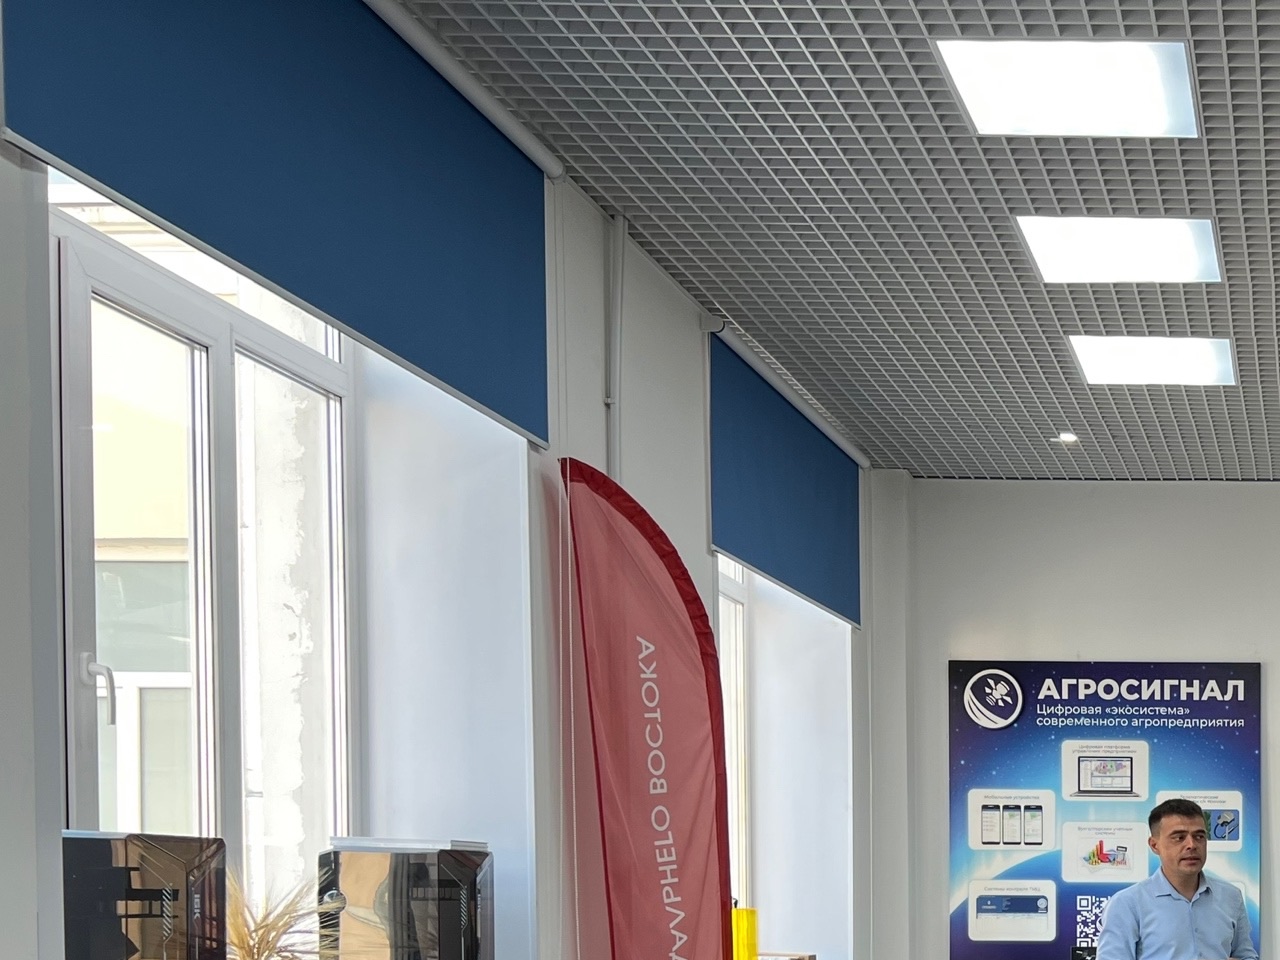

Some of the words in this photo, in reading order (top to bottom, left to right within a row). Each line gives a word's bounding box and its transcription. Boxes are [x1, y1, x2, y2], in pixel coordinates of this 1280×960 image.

[1037, 678, 1245, 701] АГРОСИГНАЛ
[1036, 703, 1102, 716] Цифровая
[1105, 705, 1190, 715] «экосистема»
[1036, 717, 1128, 728] современного
[1131, 718, 1245, 729] агропредприятия
